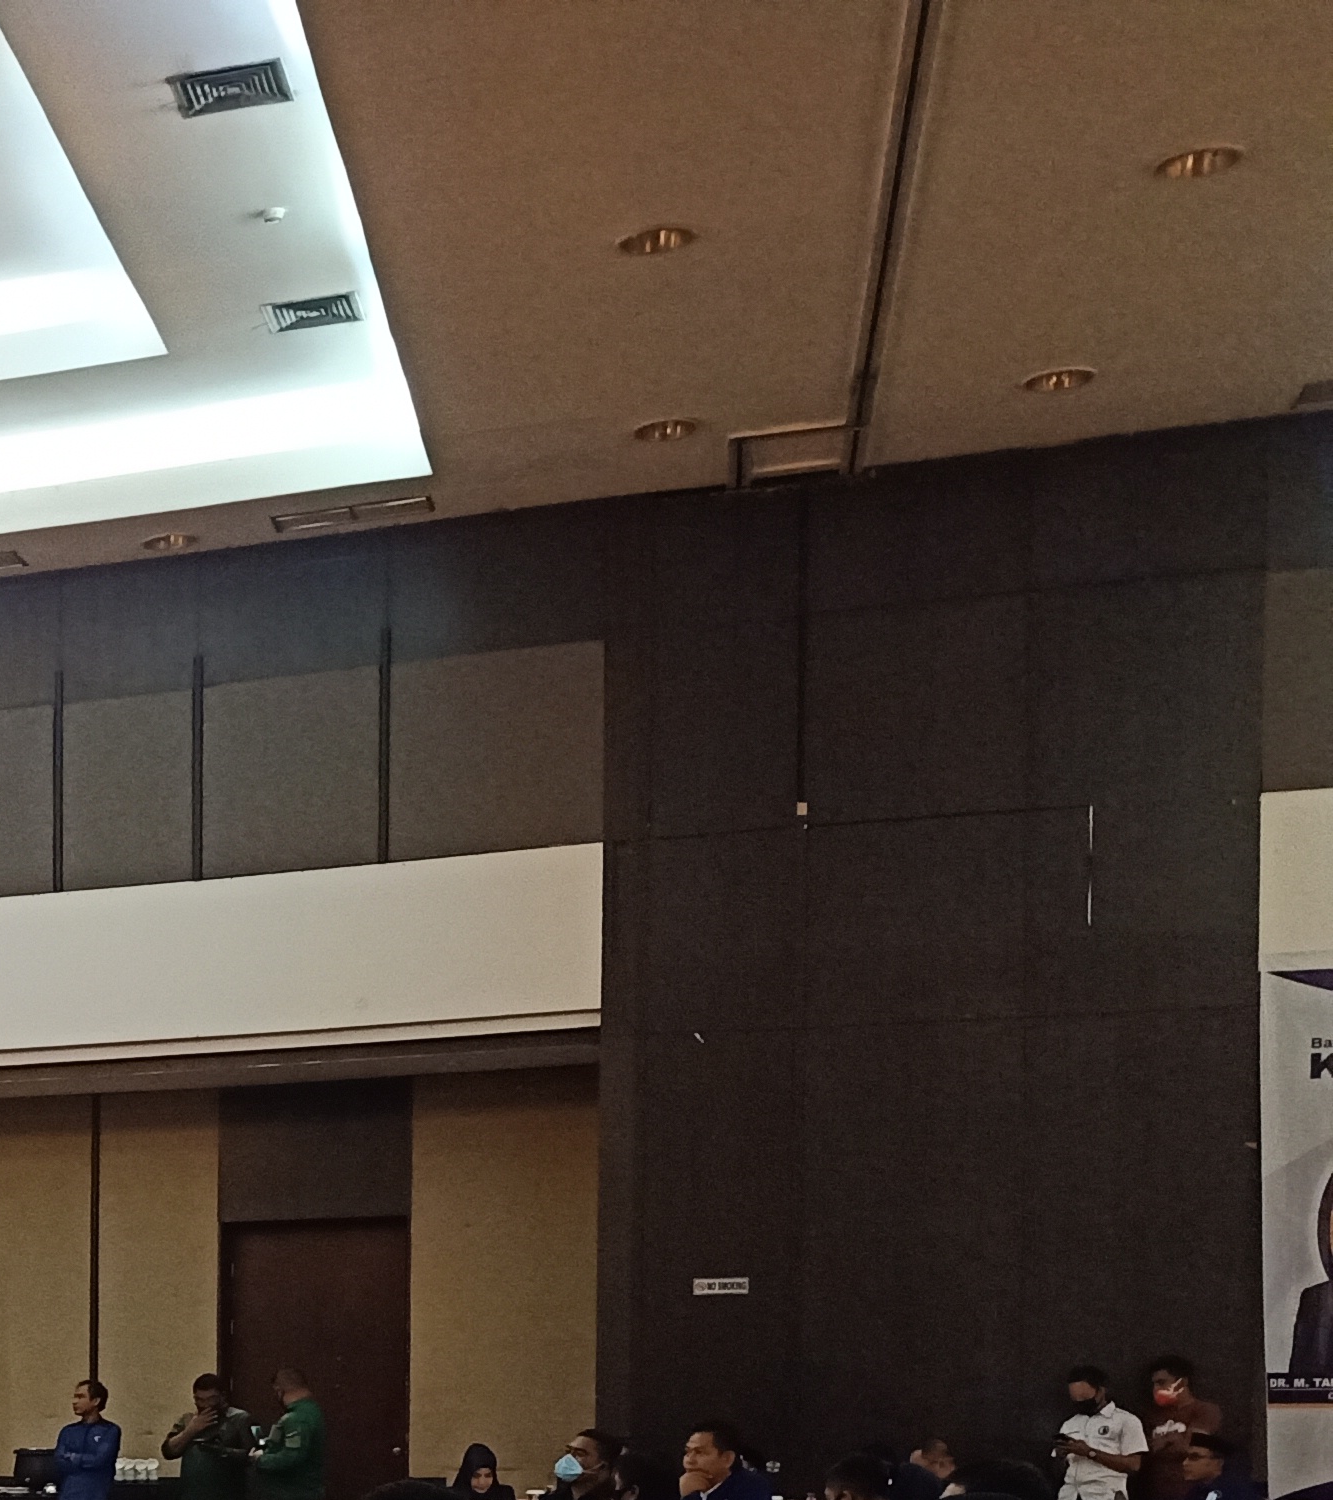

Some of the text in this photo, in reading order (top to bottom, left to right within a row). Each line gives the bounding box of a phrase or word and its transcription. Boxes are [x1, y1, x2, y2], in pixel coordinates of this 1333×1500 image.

[1269, 1377, 1333, 1388] DR. M. TA
